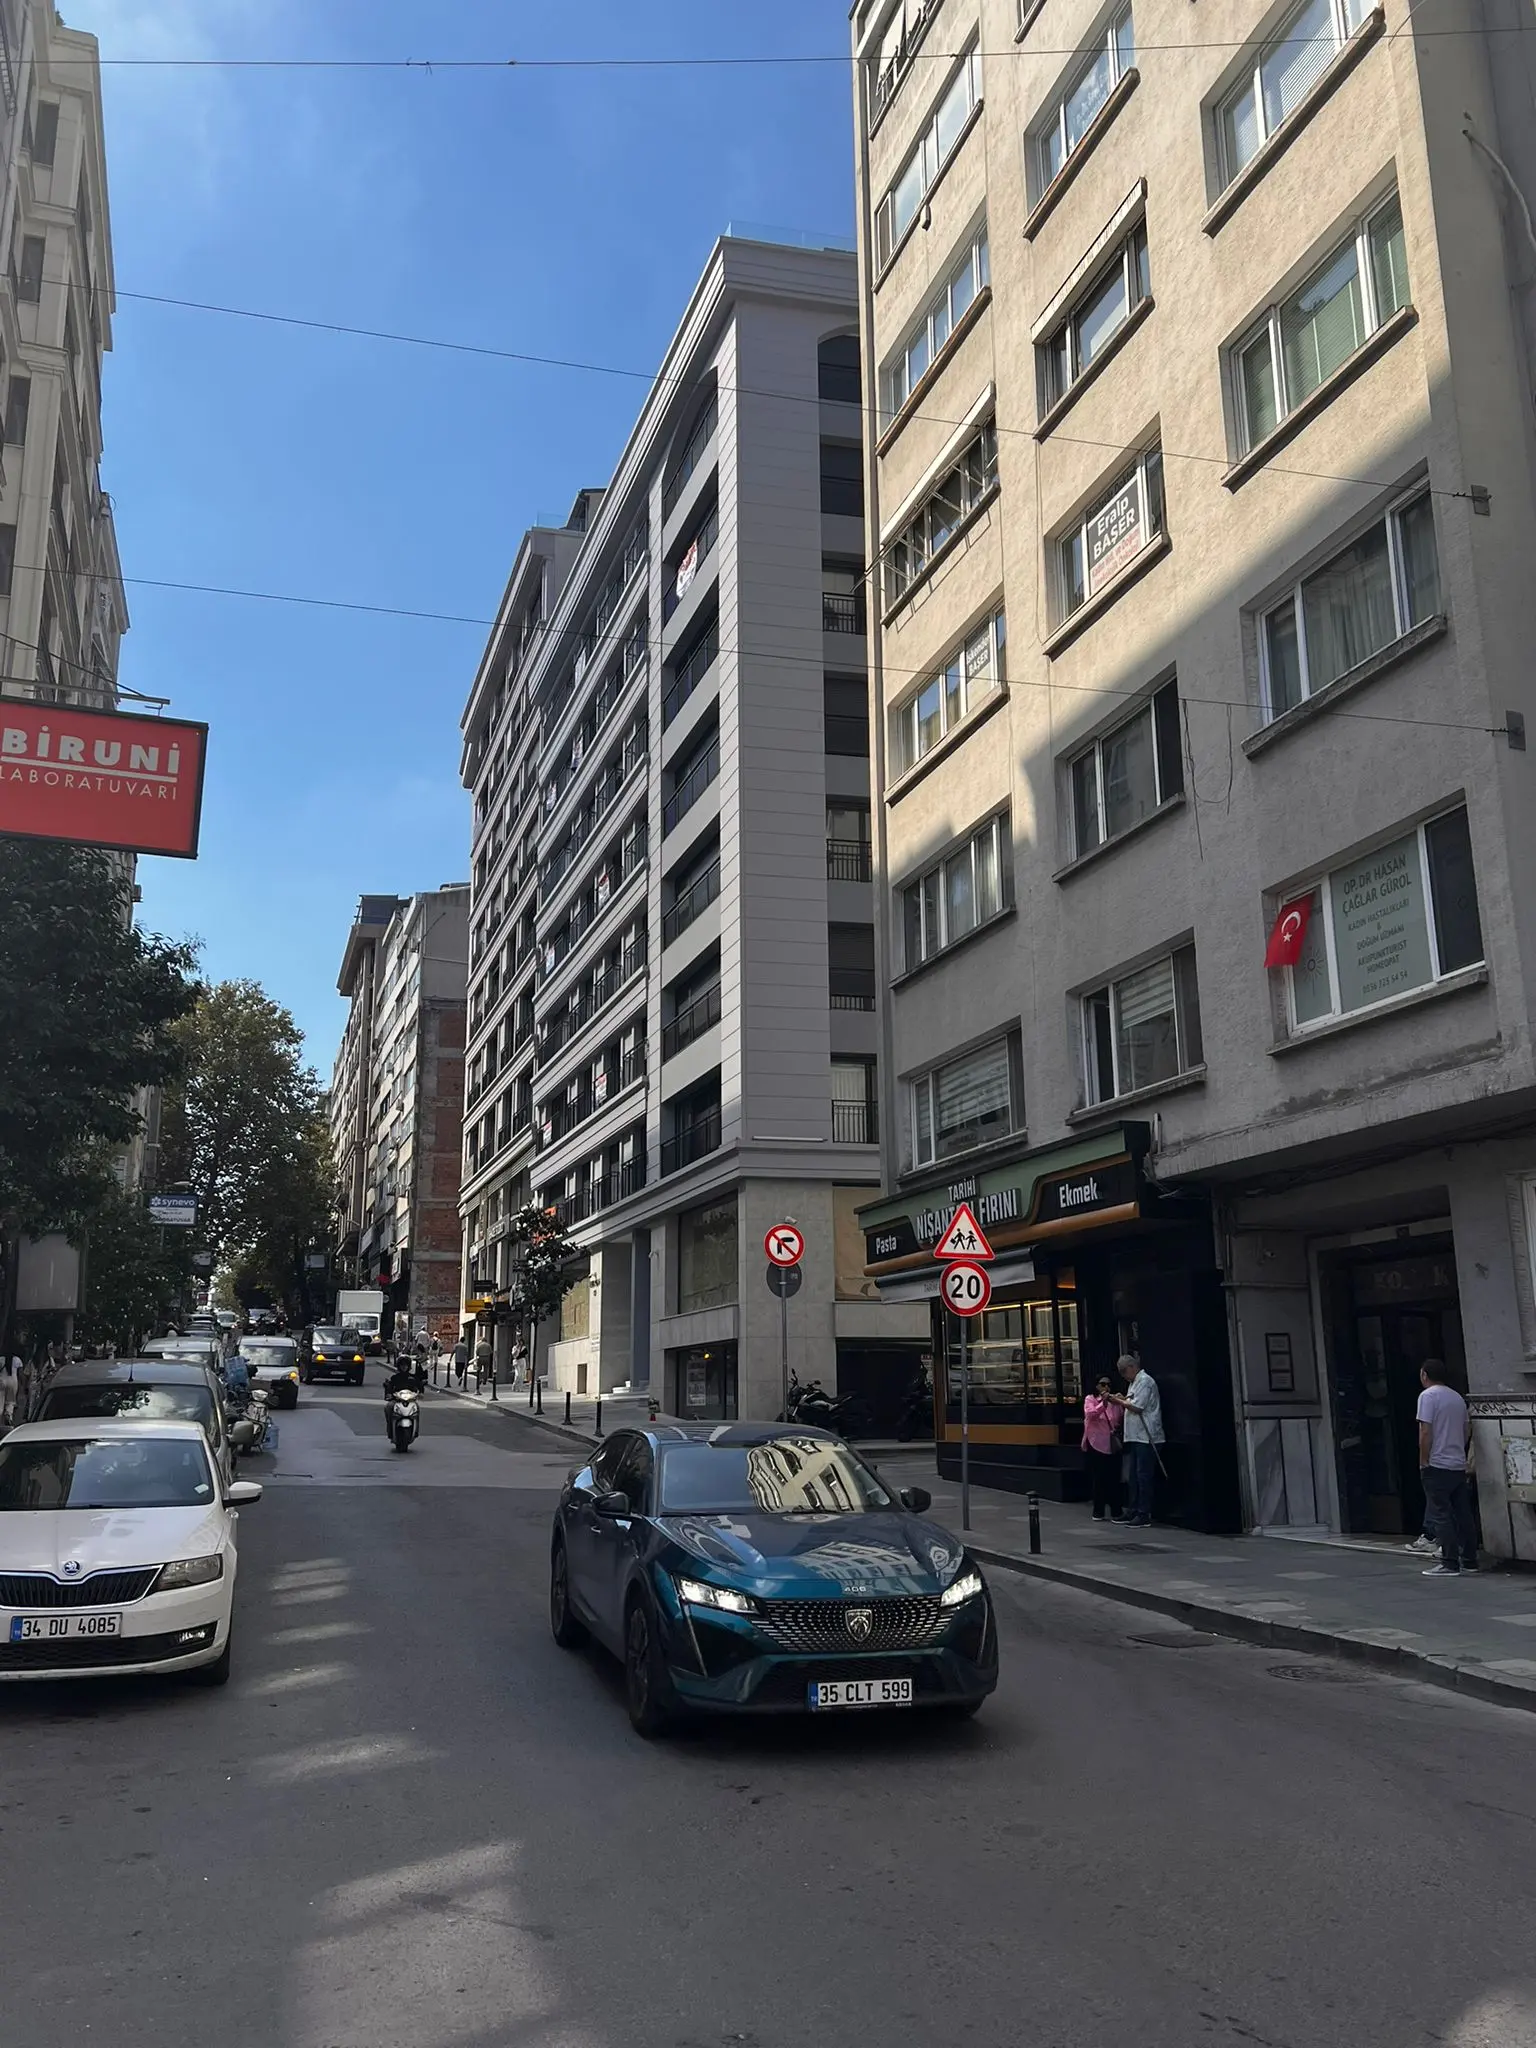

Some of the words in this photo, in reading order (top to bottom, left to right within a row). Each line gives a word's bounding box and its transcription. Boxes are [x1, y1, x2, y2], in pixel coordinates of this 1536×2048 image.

[1097, 496, 1129, 537] Eralp
[1093, 507, 1136, 561] BAŞER
[2, 725, 181, 775] BİRUNİ
[0, 766, 177, 800] LABORATUVARI
[1374, 853, 1407, 881] HASAN
[1342, 888, 1379, 918] ÇAĞLAR
[1380, 872, 1413, 897] GÜROL
[162, 1199, 195, 1207] synevo
[948, 1175, 977, 1202] TARİHİ
[1059, 1176, 1099, 1209] Ekmek
[979, 1188, 1018, 1224] FIRINI
[876, 1235, 898, 1255] Pasta
[950, 1273, 982, 1299] 20
[22, 1619, 41, 1637] 34
[50, 1618, 69, 1635] DU
[77, 1616, 117, 1634] 4085
[820, 1684, 839, 1704] 35
[845, 1682, 874, 1702] CLT
[881, 1680, 910, 1700] 599
